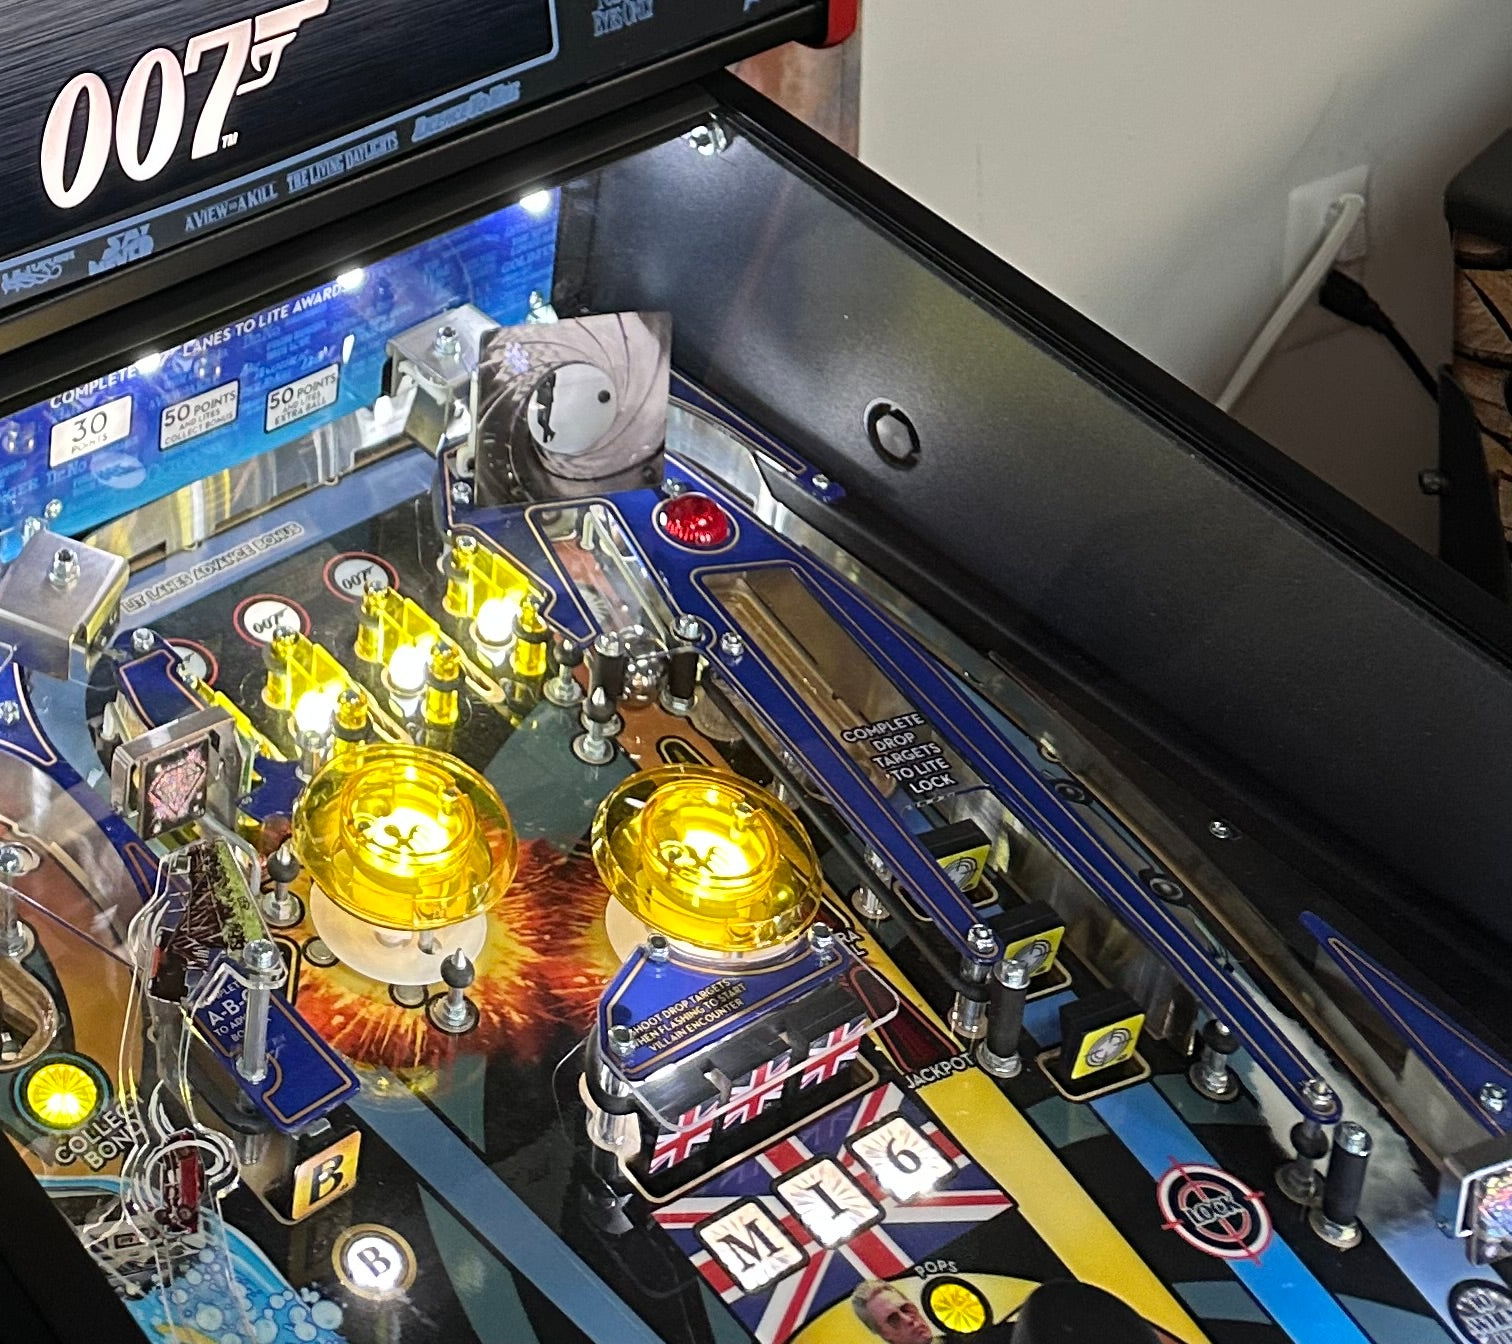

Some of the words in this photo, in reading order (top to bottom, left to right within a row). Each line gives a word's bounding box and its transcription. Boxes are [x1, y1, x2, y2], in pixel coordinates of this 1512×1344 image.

[41, 12, 254, 209] 007
[221, 132, 238, 148] TM
[49, 367, 137, 409] COMPLETE
[182, 326, 231, 357] LANES
[234, 317, 255, 338] TO
[257, 303, 290, 330] LITE
[164, 404, 190, 428] 50
[194, 390, 236, 414] POINTS
[270, 387, 294, 410] 50
[297, 373, 336, 397] POINTS
[71, 411, 108, 443] 30
[165, 425, 202, 445] COLLECT
[192, 544, 254, 581] ADVANCE
[256, 522, 304, 551] BONUS
[842, 712, 925, 744] COMPLETE
[872, 730, 915, 753] DROP
[872, 741, 942, 770] TARGETS
[891, 764, 914, 783] TO
[914, 757, 950, 777] LITE
[908, 773, 957, 796] LOCK
[659, 1005, 704, 1034] FLASHING
[705, 997, 720, 1012] TO
[719, 982, 748, 1002] START
[662, 996, 689, 1020] DROP
[689, 977, 732, 1005] TARGETS
[648, 1026, 686, 1053] VILLAIN
[686, 997, 744, 1033] ENCOUNTER
[905, 1051, 974, 1090] JACKPOT
[886, 1138, 922, 1175] 6
[311, 1153, 345, 1204] B
[818, 1181, 854, 1218] I
[1185, 1192, 1242, 1228] LOCK
[357, 1246, 391, 1278] B
[719, 1217, 782, 1273] M
[915, 1256, 959, 1280] POPS
